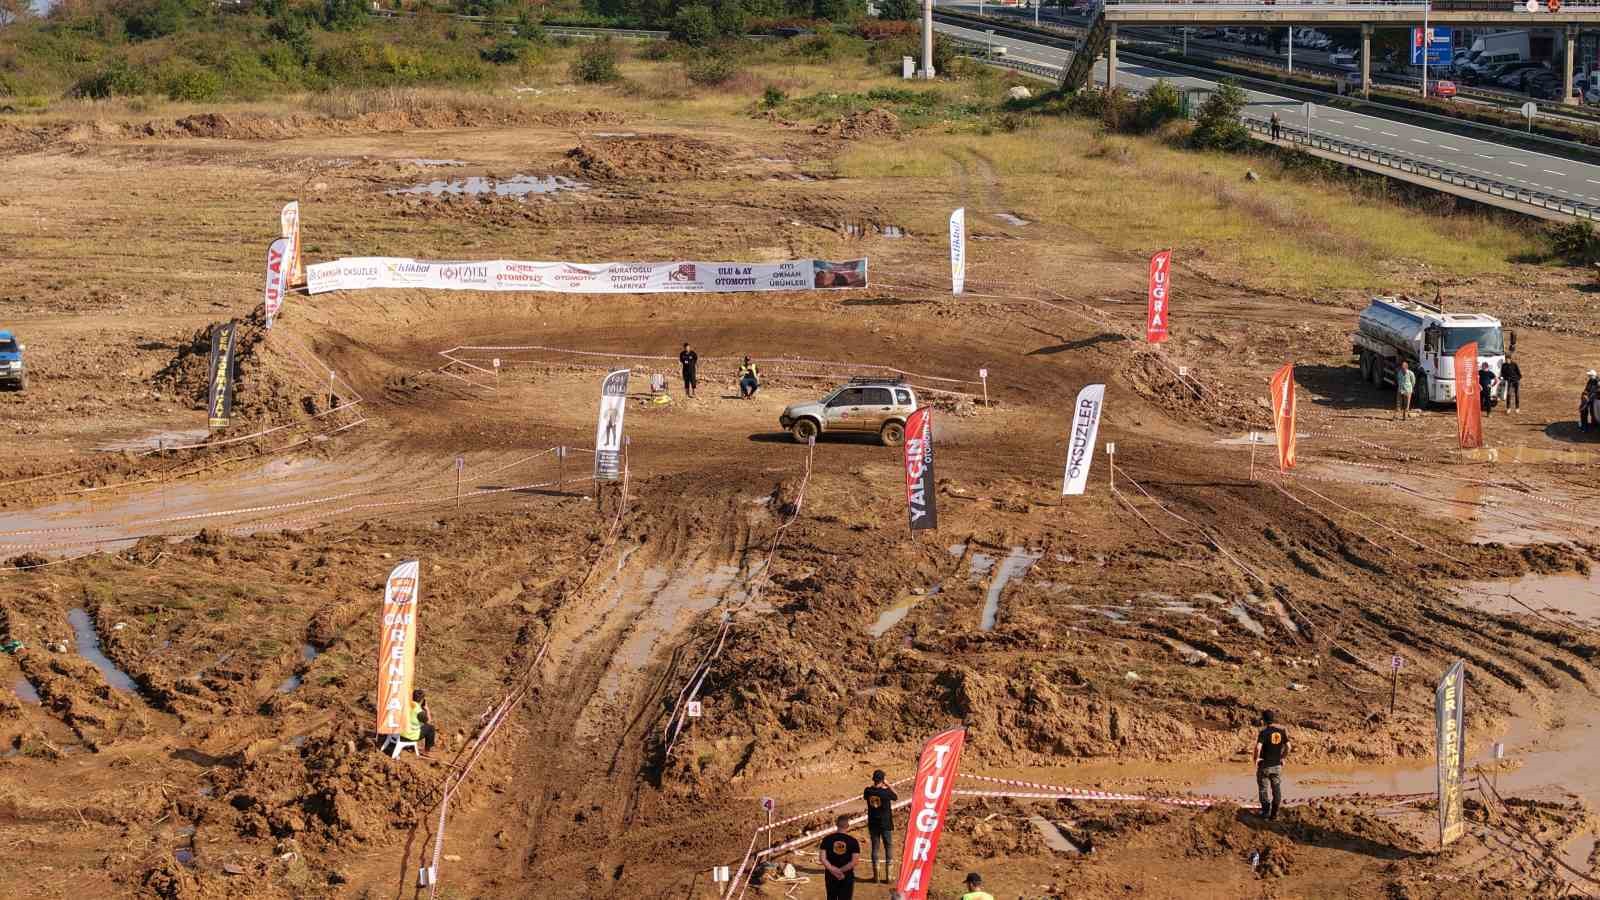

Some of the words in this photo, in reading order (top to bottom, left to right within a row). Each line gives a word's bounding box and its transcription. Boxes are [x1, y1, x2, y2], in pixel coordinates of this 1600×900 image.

[906, 439, 927, 521] YALÇIN
[387, 629, 405, 728] RENTAL
[1445, 675, 1457, 711] VER
